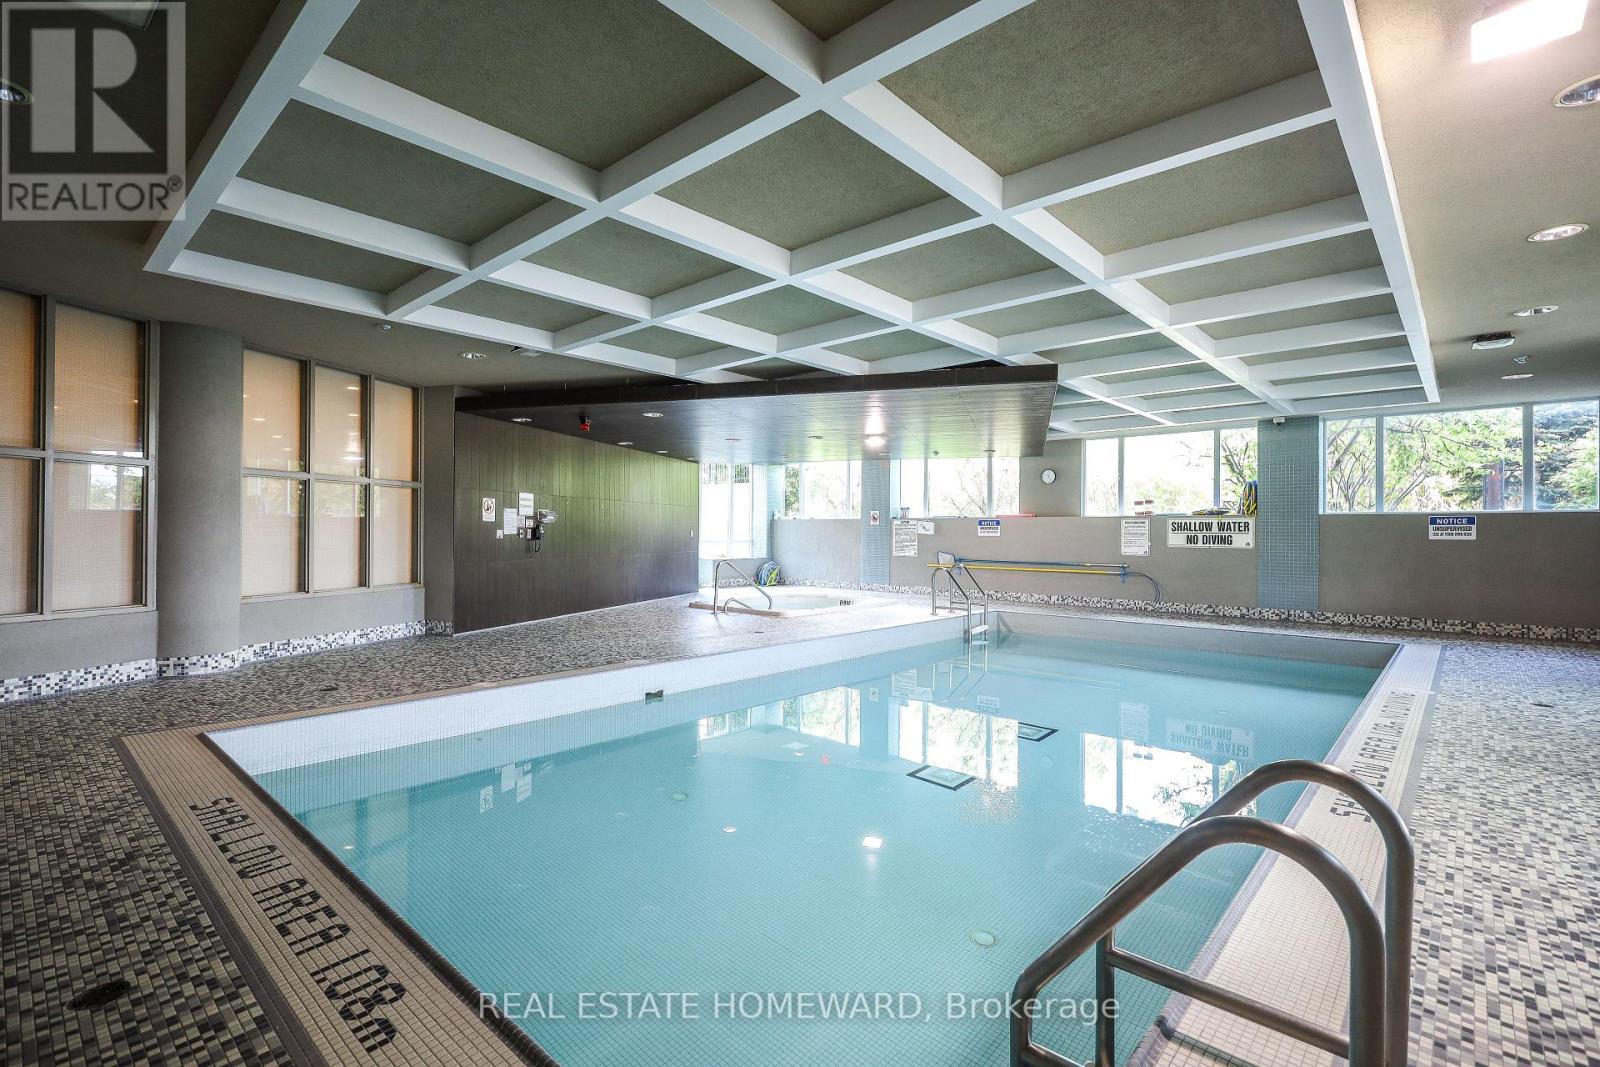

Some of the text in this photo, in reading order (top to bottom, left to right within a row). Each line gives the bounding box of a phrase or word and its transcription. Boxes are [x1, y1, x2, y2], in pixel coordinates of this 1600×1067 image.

[1171, 521, 1250, 532] SHALLOW WATER
[1436, 517, 1468, 525] NOTICE
[1186, 534, 1233, 545] NO DIVING
[188, 797, 291, 879] SHALLOW
[252, 878, 350, 956] AREA
